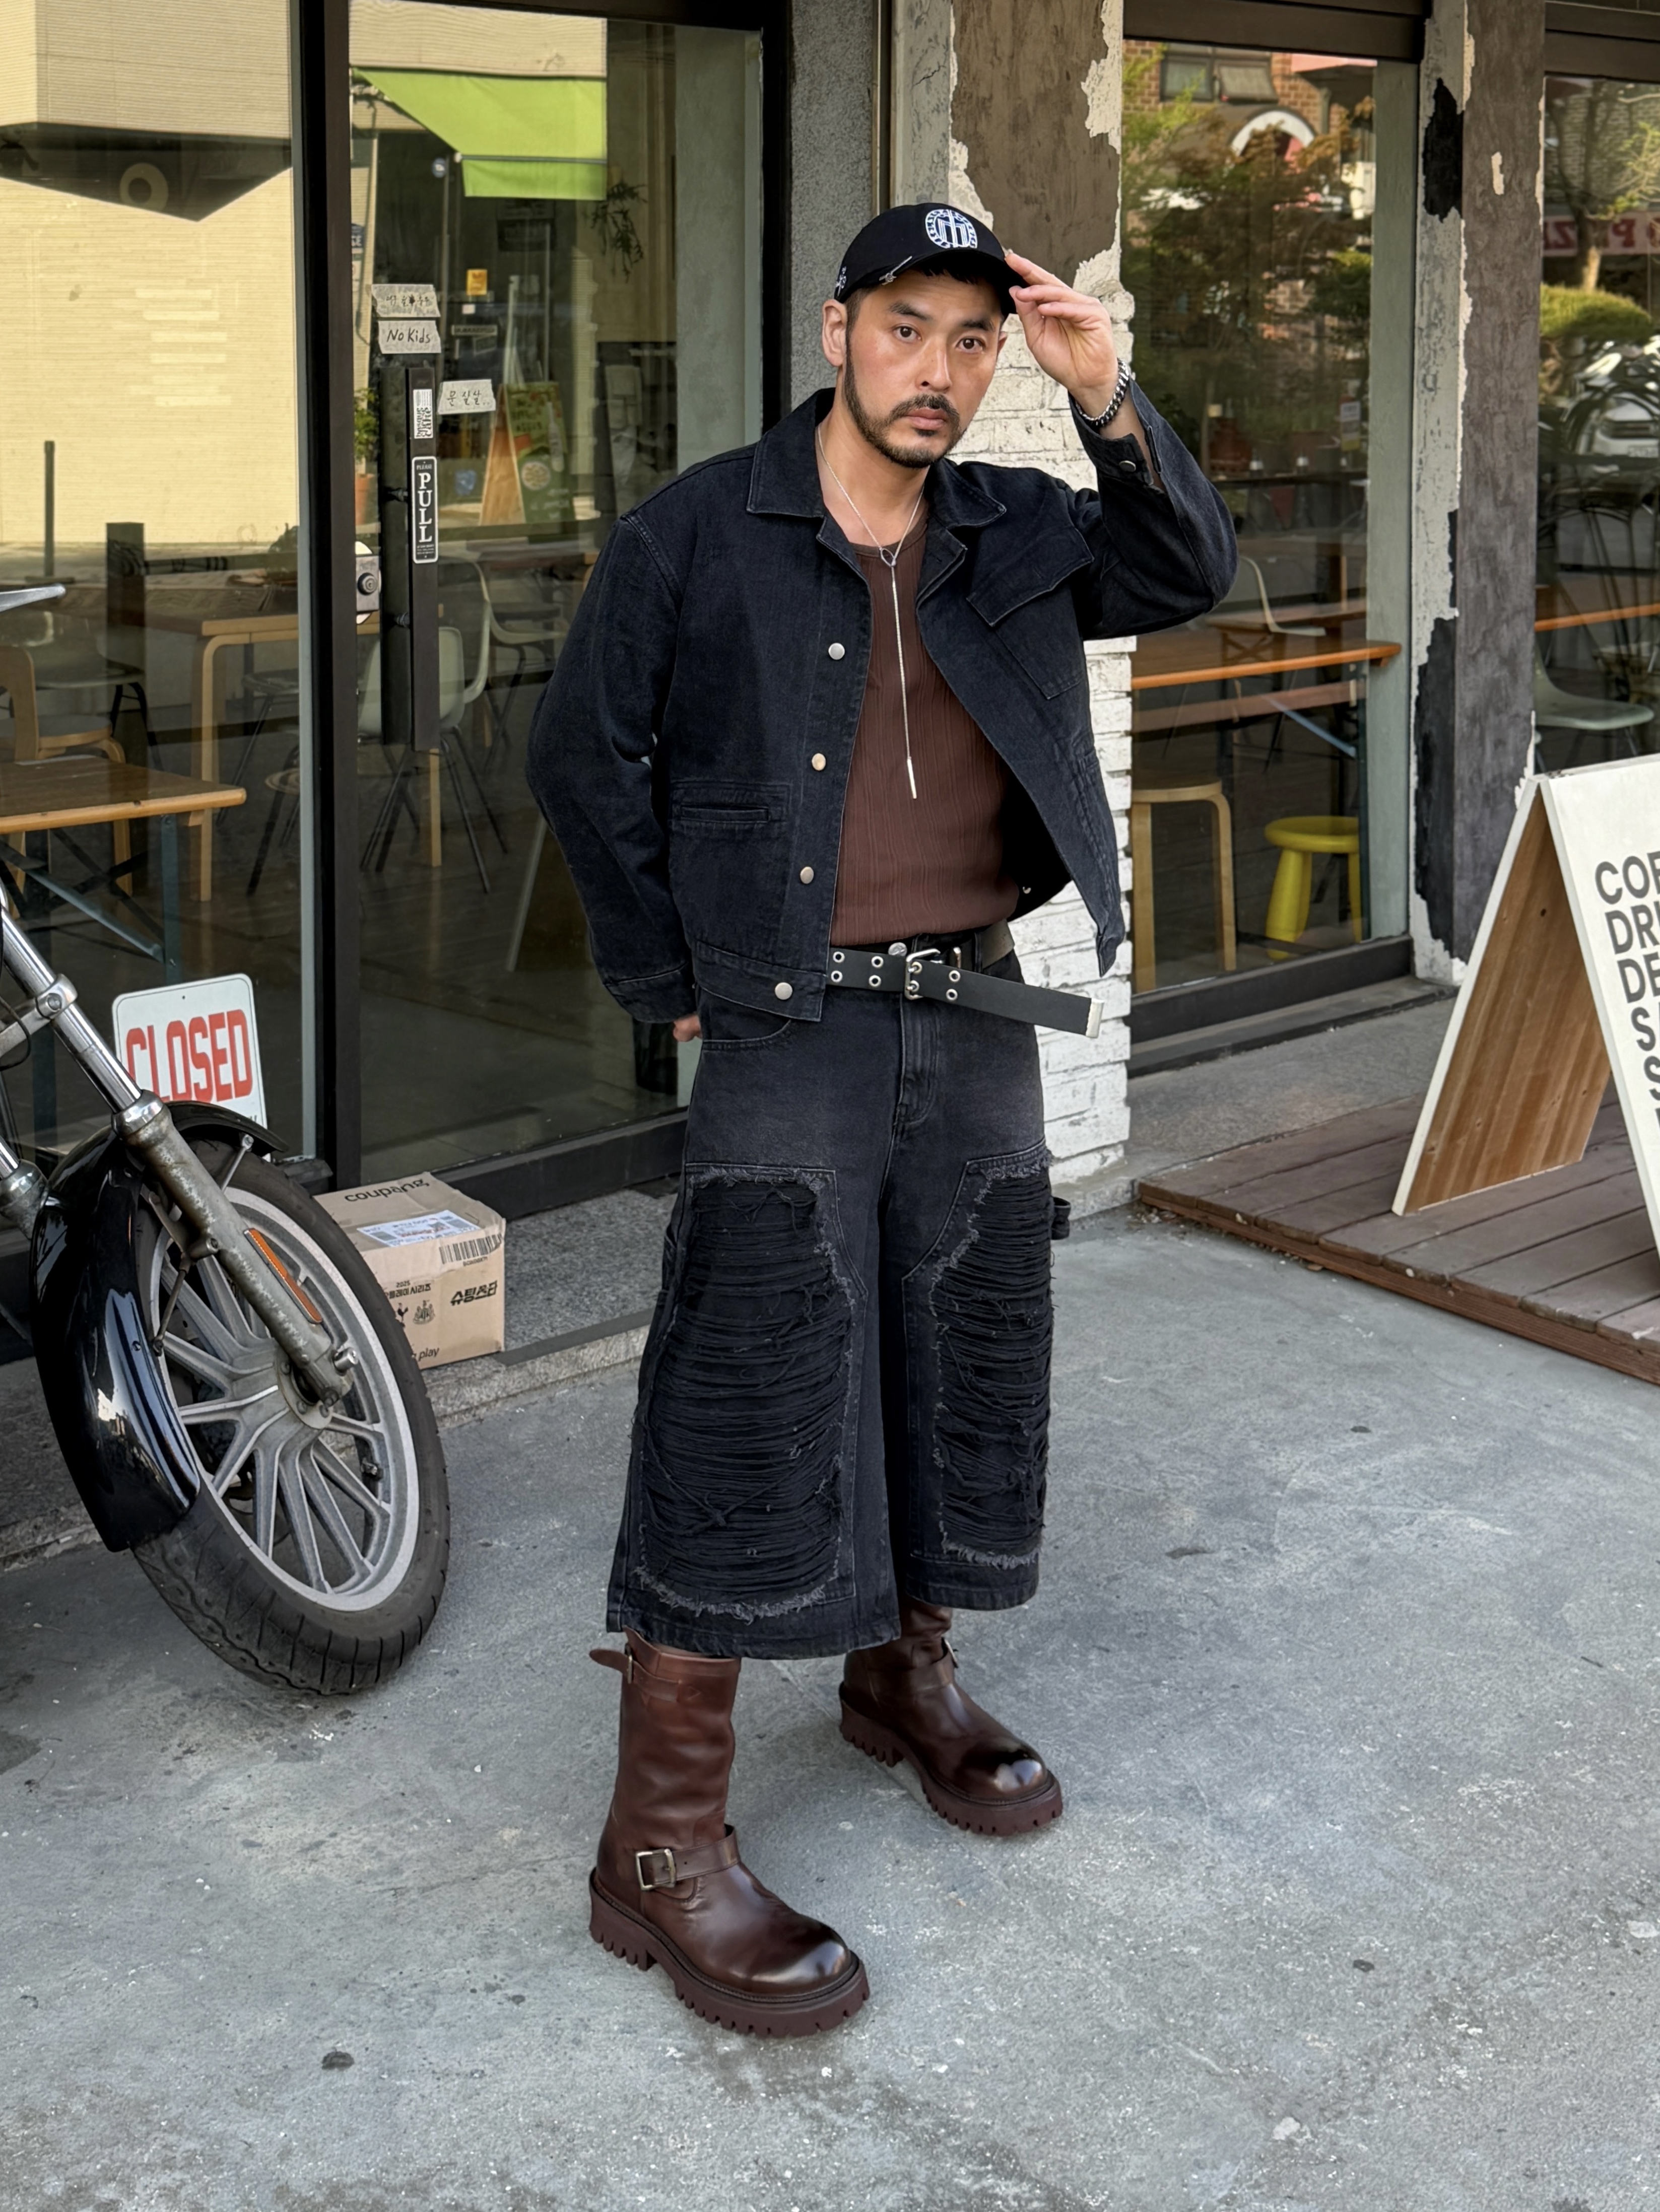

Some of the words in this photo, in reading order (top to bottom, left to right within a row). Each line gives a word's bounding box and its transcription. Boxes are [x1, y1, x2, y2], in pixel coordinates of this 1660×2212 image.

[387, 329, 404, 342] No
[408, 326, 431, 343] Kids
[447, 391, 456, 406] 문
[417, 472, 433, 543] PULL
[126, 1009, 253, 1103] CLOSED
[345, 1179, 430, 1202] coupang
[418, 1347, 439, 1361] play
